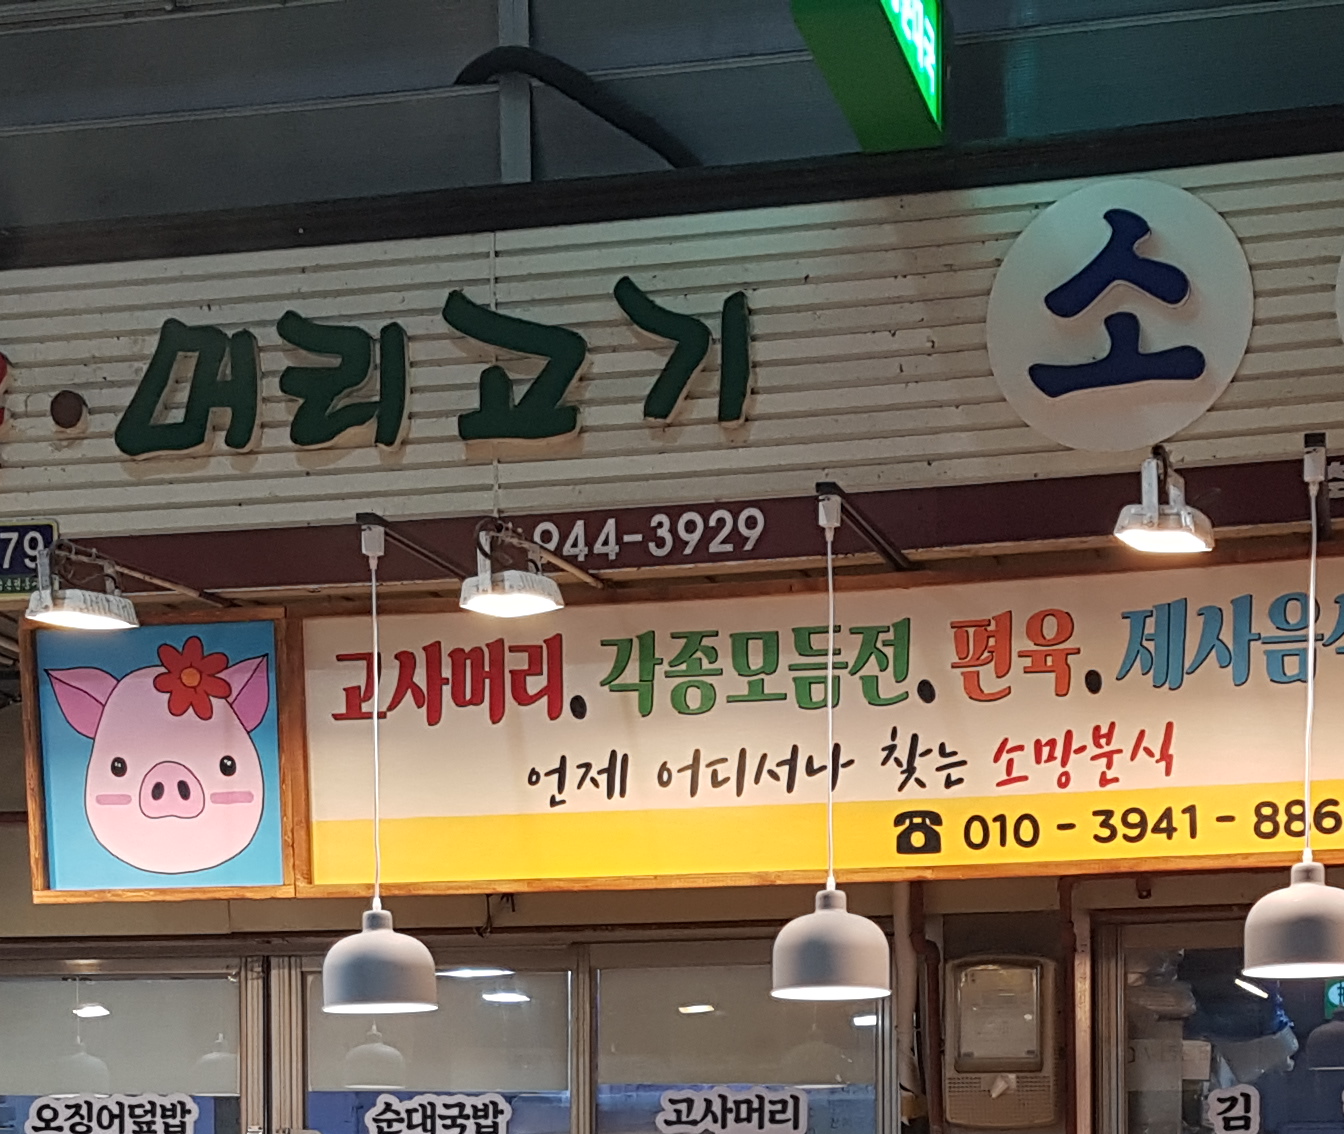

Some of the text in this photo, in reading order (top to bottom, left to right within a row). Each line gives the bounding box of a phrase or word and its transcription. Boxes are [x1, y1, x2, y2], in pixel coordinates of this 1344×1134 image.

[114, 276, 752, 457] 머리고기
[527, 720, 1175, 808] 언제 어디서나 찾는 소망분식
[663, 1094, 802, 1130] 고사머리
